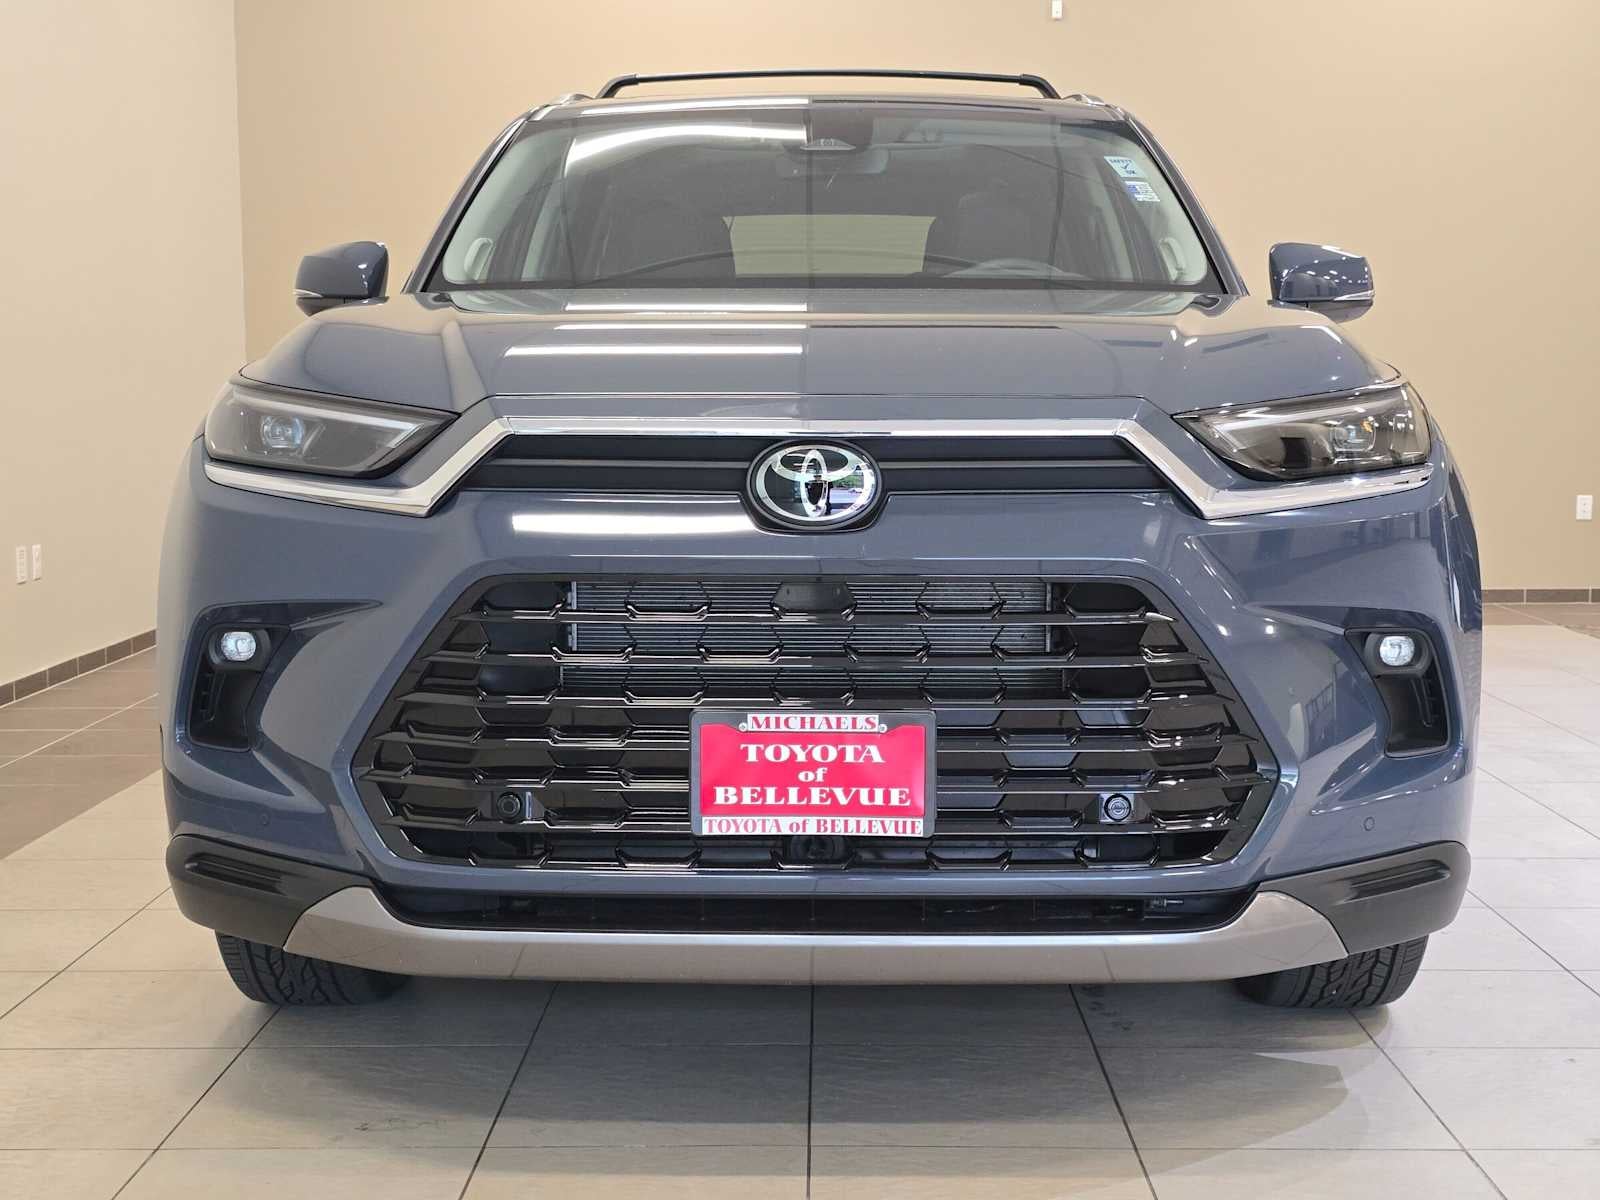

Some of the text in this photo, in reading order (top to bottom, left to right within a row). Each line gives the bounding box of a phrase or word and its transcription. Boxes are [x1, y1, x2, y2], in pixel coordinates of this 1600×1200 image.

[751, 716, 878, 730] MICHAELS
[741, 744, 884, 762] TOYOTA
[798, 768, 827, 782] of
[714, 787, 911, 805] BELLEVUE
[705, 819, 922, 835] TOYOTA of BELLEVUE
